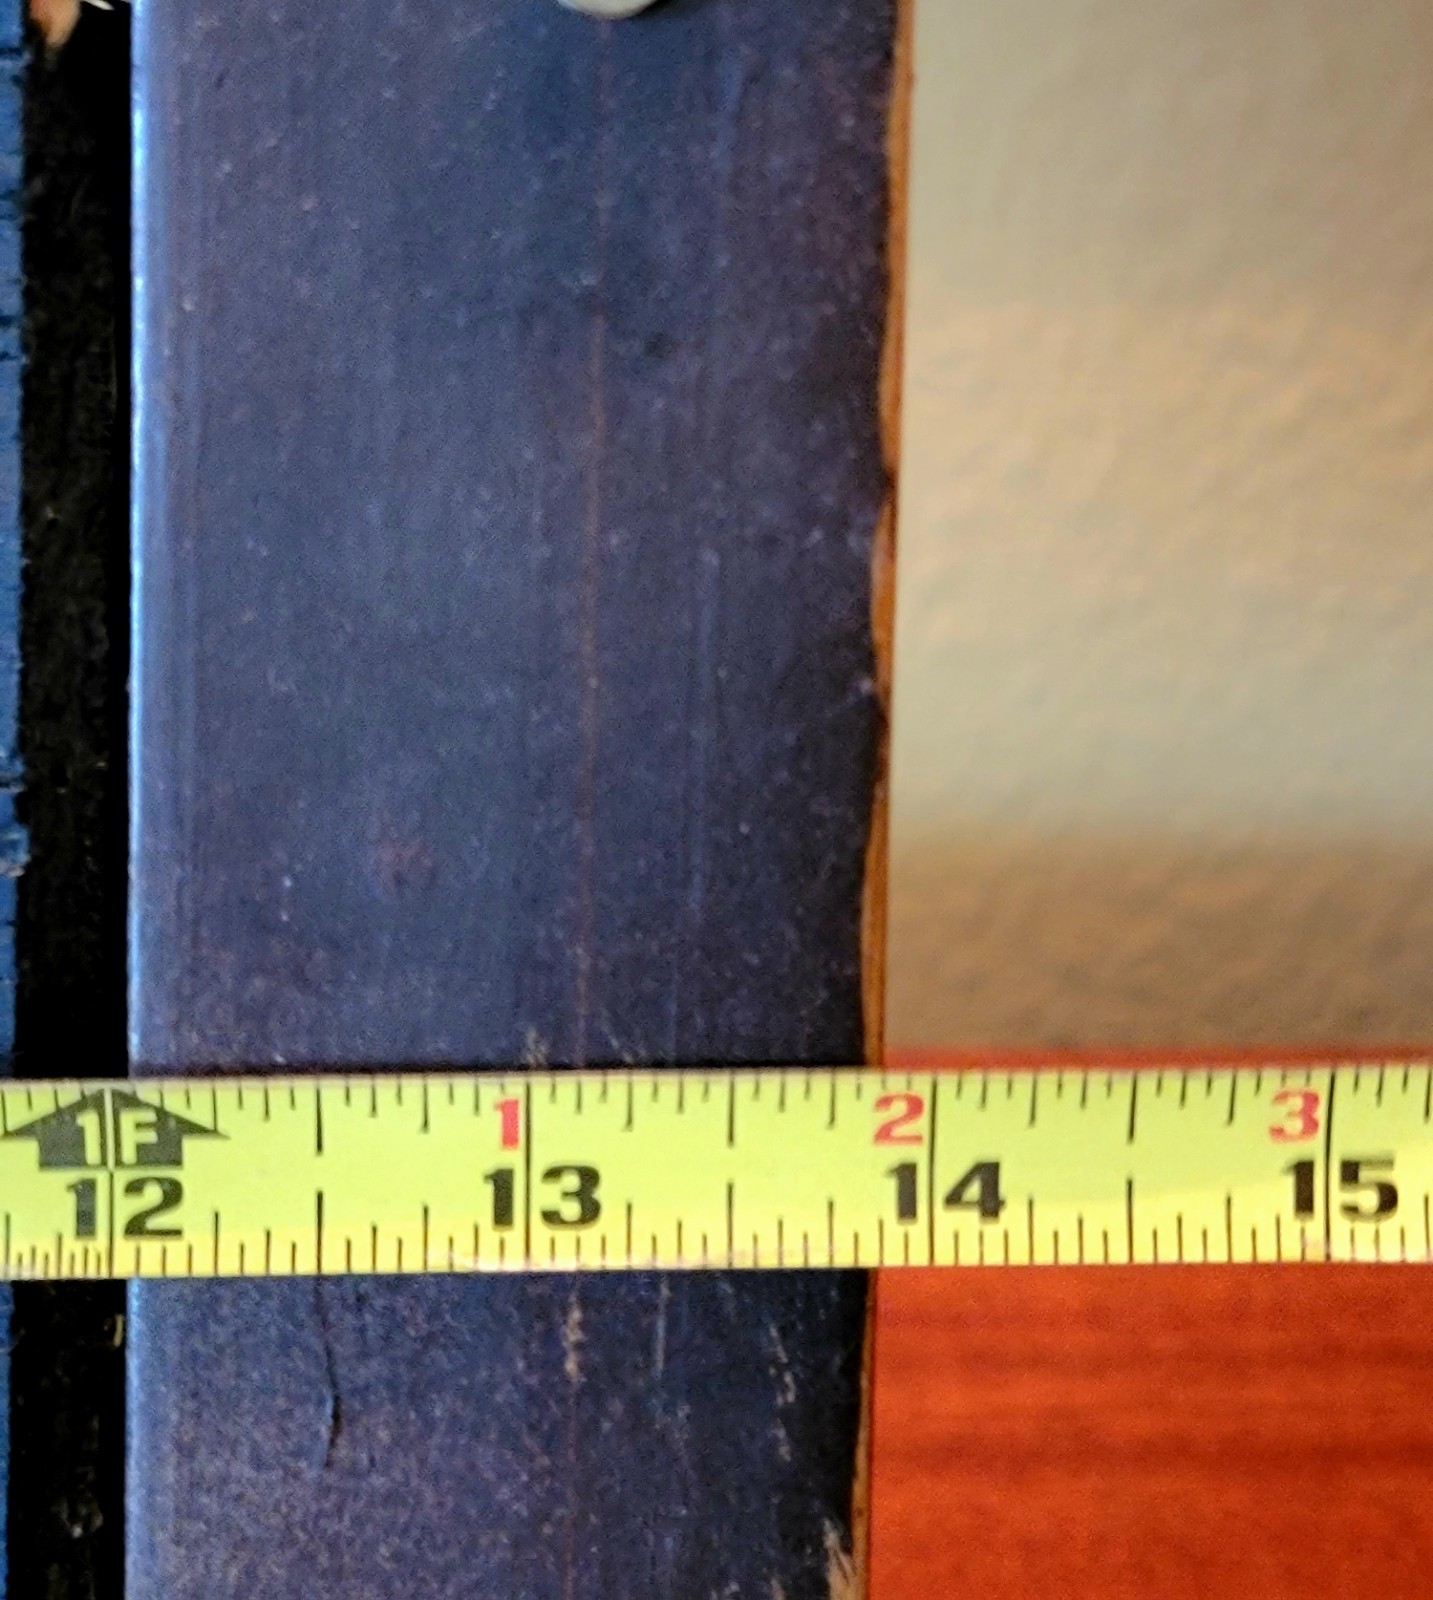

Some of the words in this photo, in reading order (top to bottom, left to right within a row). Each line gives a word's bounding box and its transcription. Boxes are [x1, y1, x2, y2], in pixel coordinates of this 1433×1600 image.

[495, 1097, 519, 1149] 1
[873, 1092, 925, 1146] 2
[1268, 1089, 1321, 1142] 3
[66, 1176, 184, 1239] 12
[484, 1165, 602, 1231] 13
[885, 1160, 1006, 1225] 14
[1282, 1158, 1399, 1223] 15
